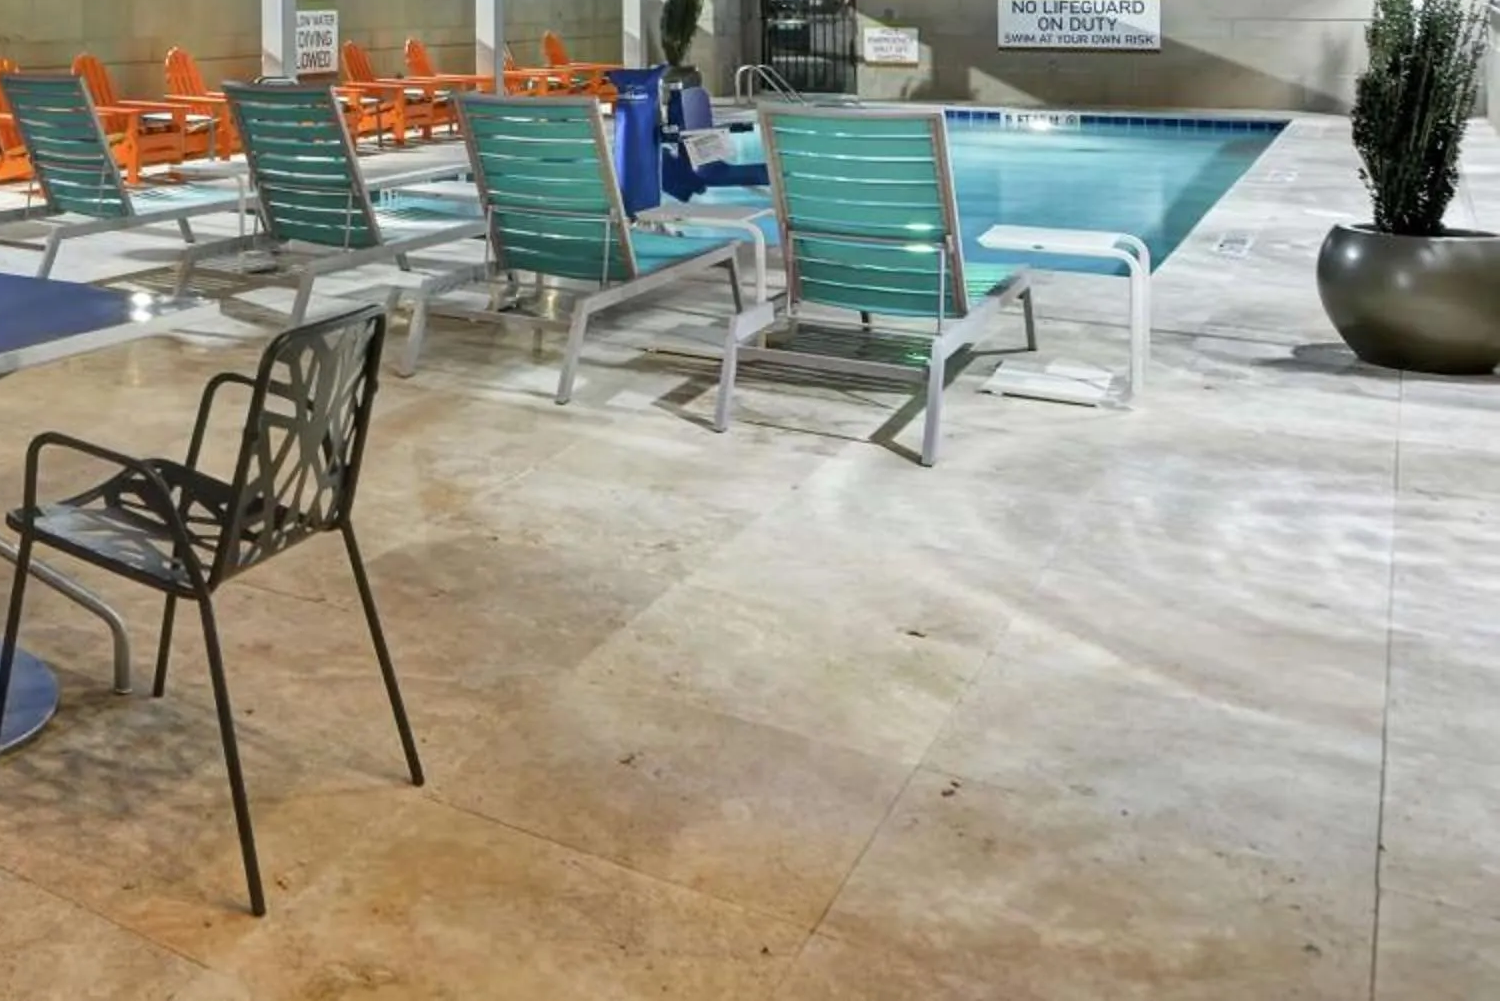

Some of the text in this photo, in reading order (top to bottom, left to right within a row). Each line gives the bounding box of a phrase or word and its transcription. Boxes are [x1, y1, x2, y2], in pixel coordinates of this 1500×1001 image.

[1011, 0, 1145, 15] NO LIFEGUARD
[1037, 17, 1118, 32] ON DUTY
[1004, 34, 1155, 45] SWIM AT YOUR OWN RISK
